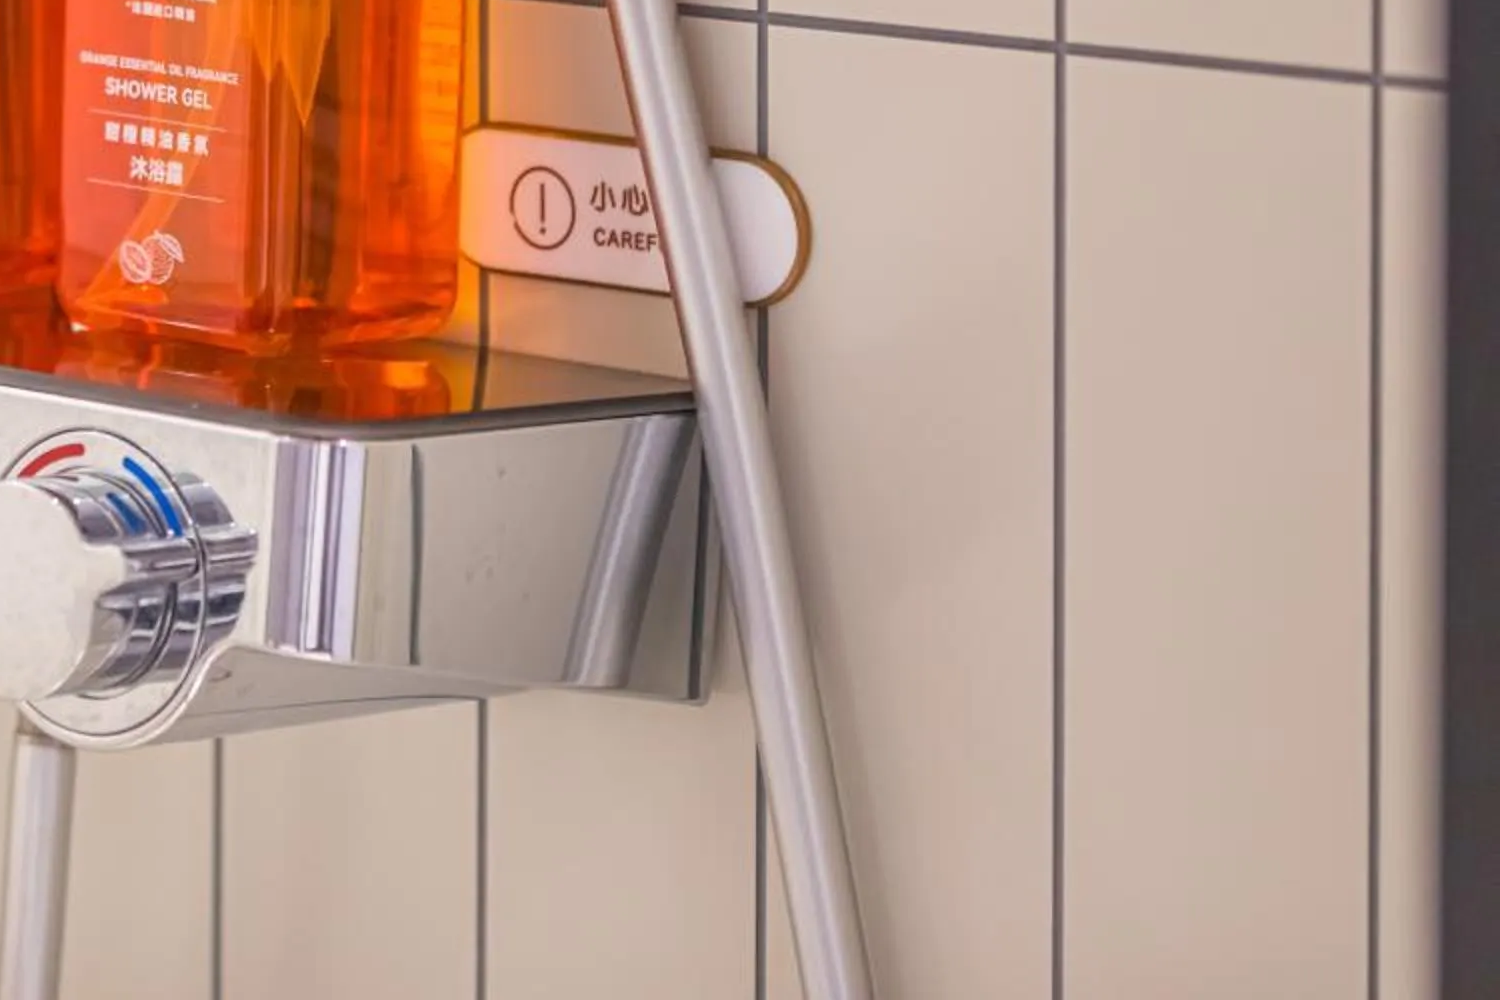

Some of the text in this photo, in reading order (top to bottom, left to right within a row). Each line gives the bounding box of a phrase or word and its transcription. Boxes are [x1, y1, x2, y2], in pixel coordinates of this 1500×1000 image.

[79, 50, 118, 68] ORANGE
[168, 62, 184, 77] OIL
[185, 66, 240, 85] FRAGRANCE
[104, 76, 213, 110] SHOWER GEL
[590, 180, 649, 216] 小心
[592, 226, 660, 252] CAREF
